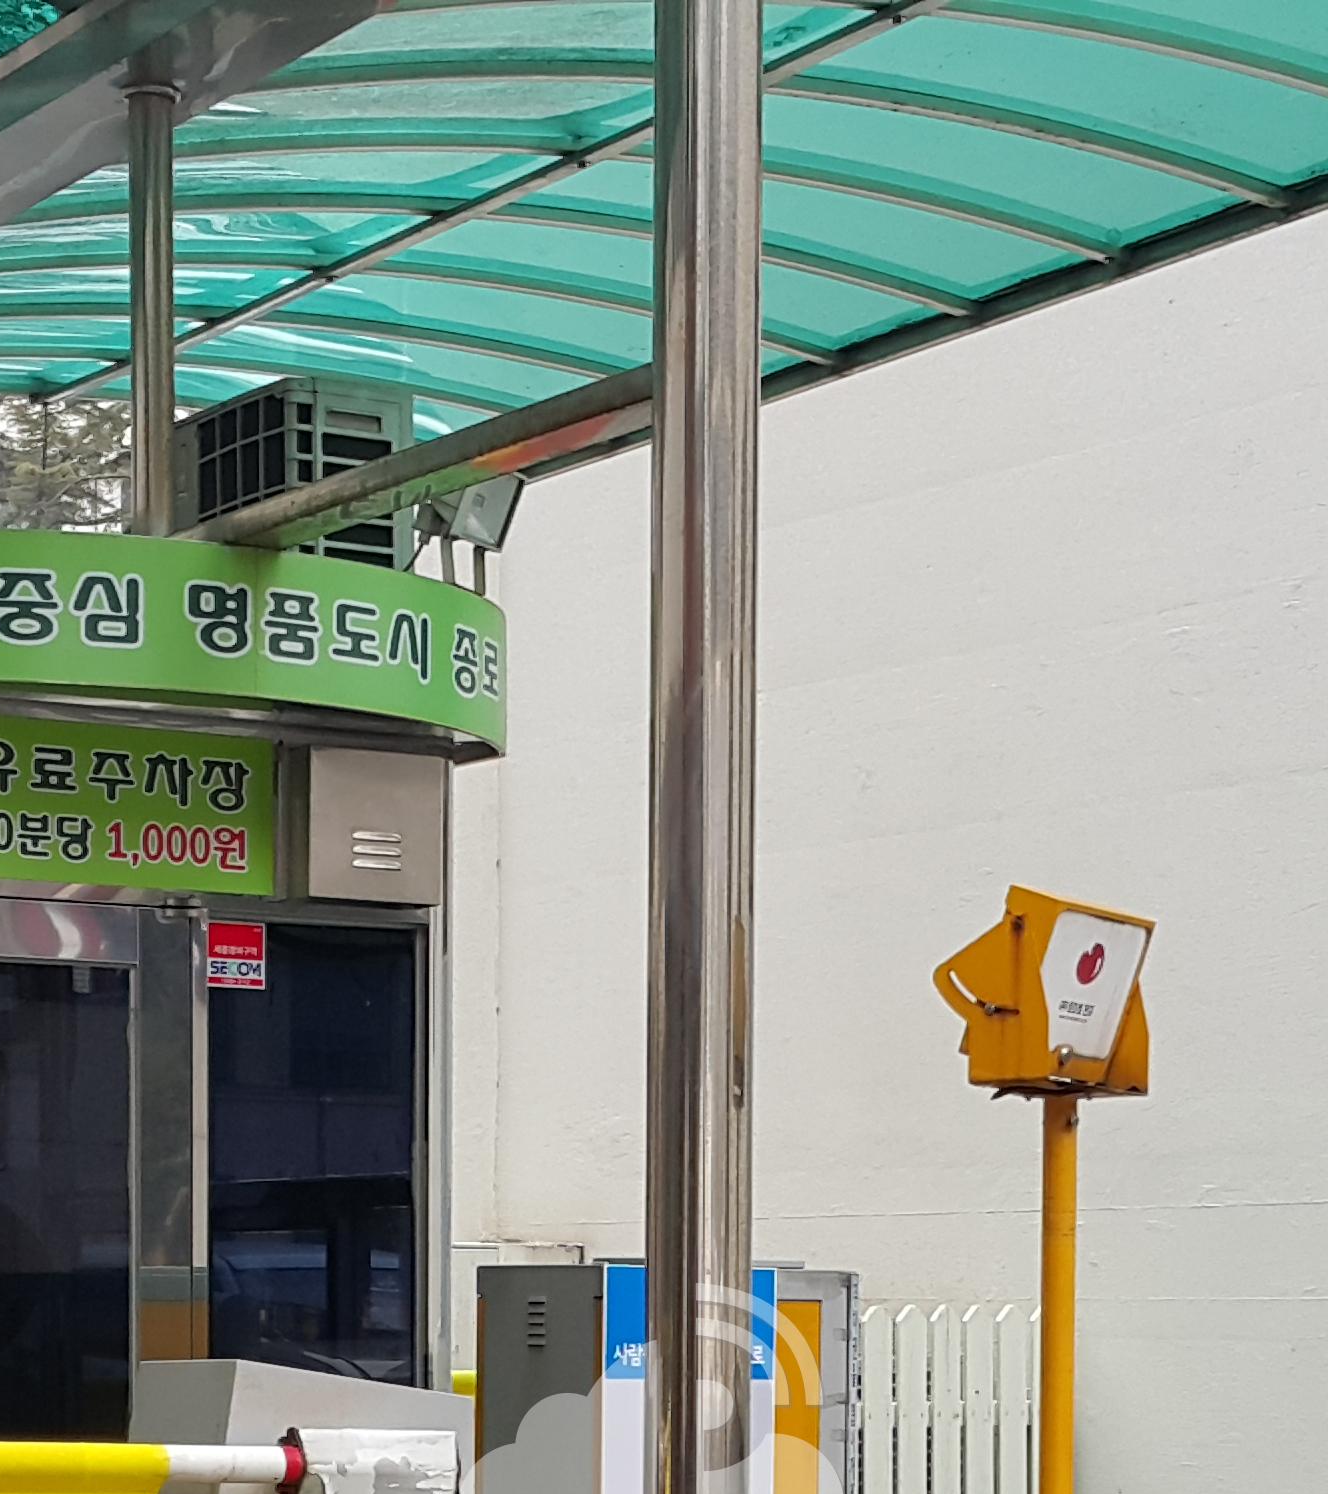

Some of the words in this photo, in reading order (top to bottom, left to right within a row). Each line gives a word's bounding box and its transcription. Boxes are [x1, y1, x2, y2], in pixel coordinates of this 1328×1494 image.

[185, 580, 432, 682] 명품도시
[451, 624, 500, 699] 종로
[106, 822, 249, 871] 1,000원
[211, 961, 262, 977] SECOM
[613, 1342, 646, 1367] 사람
